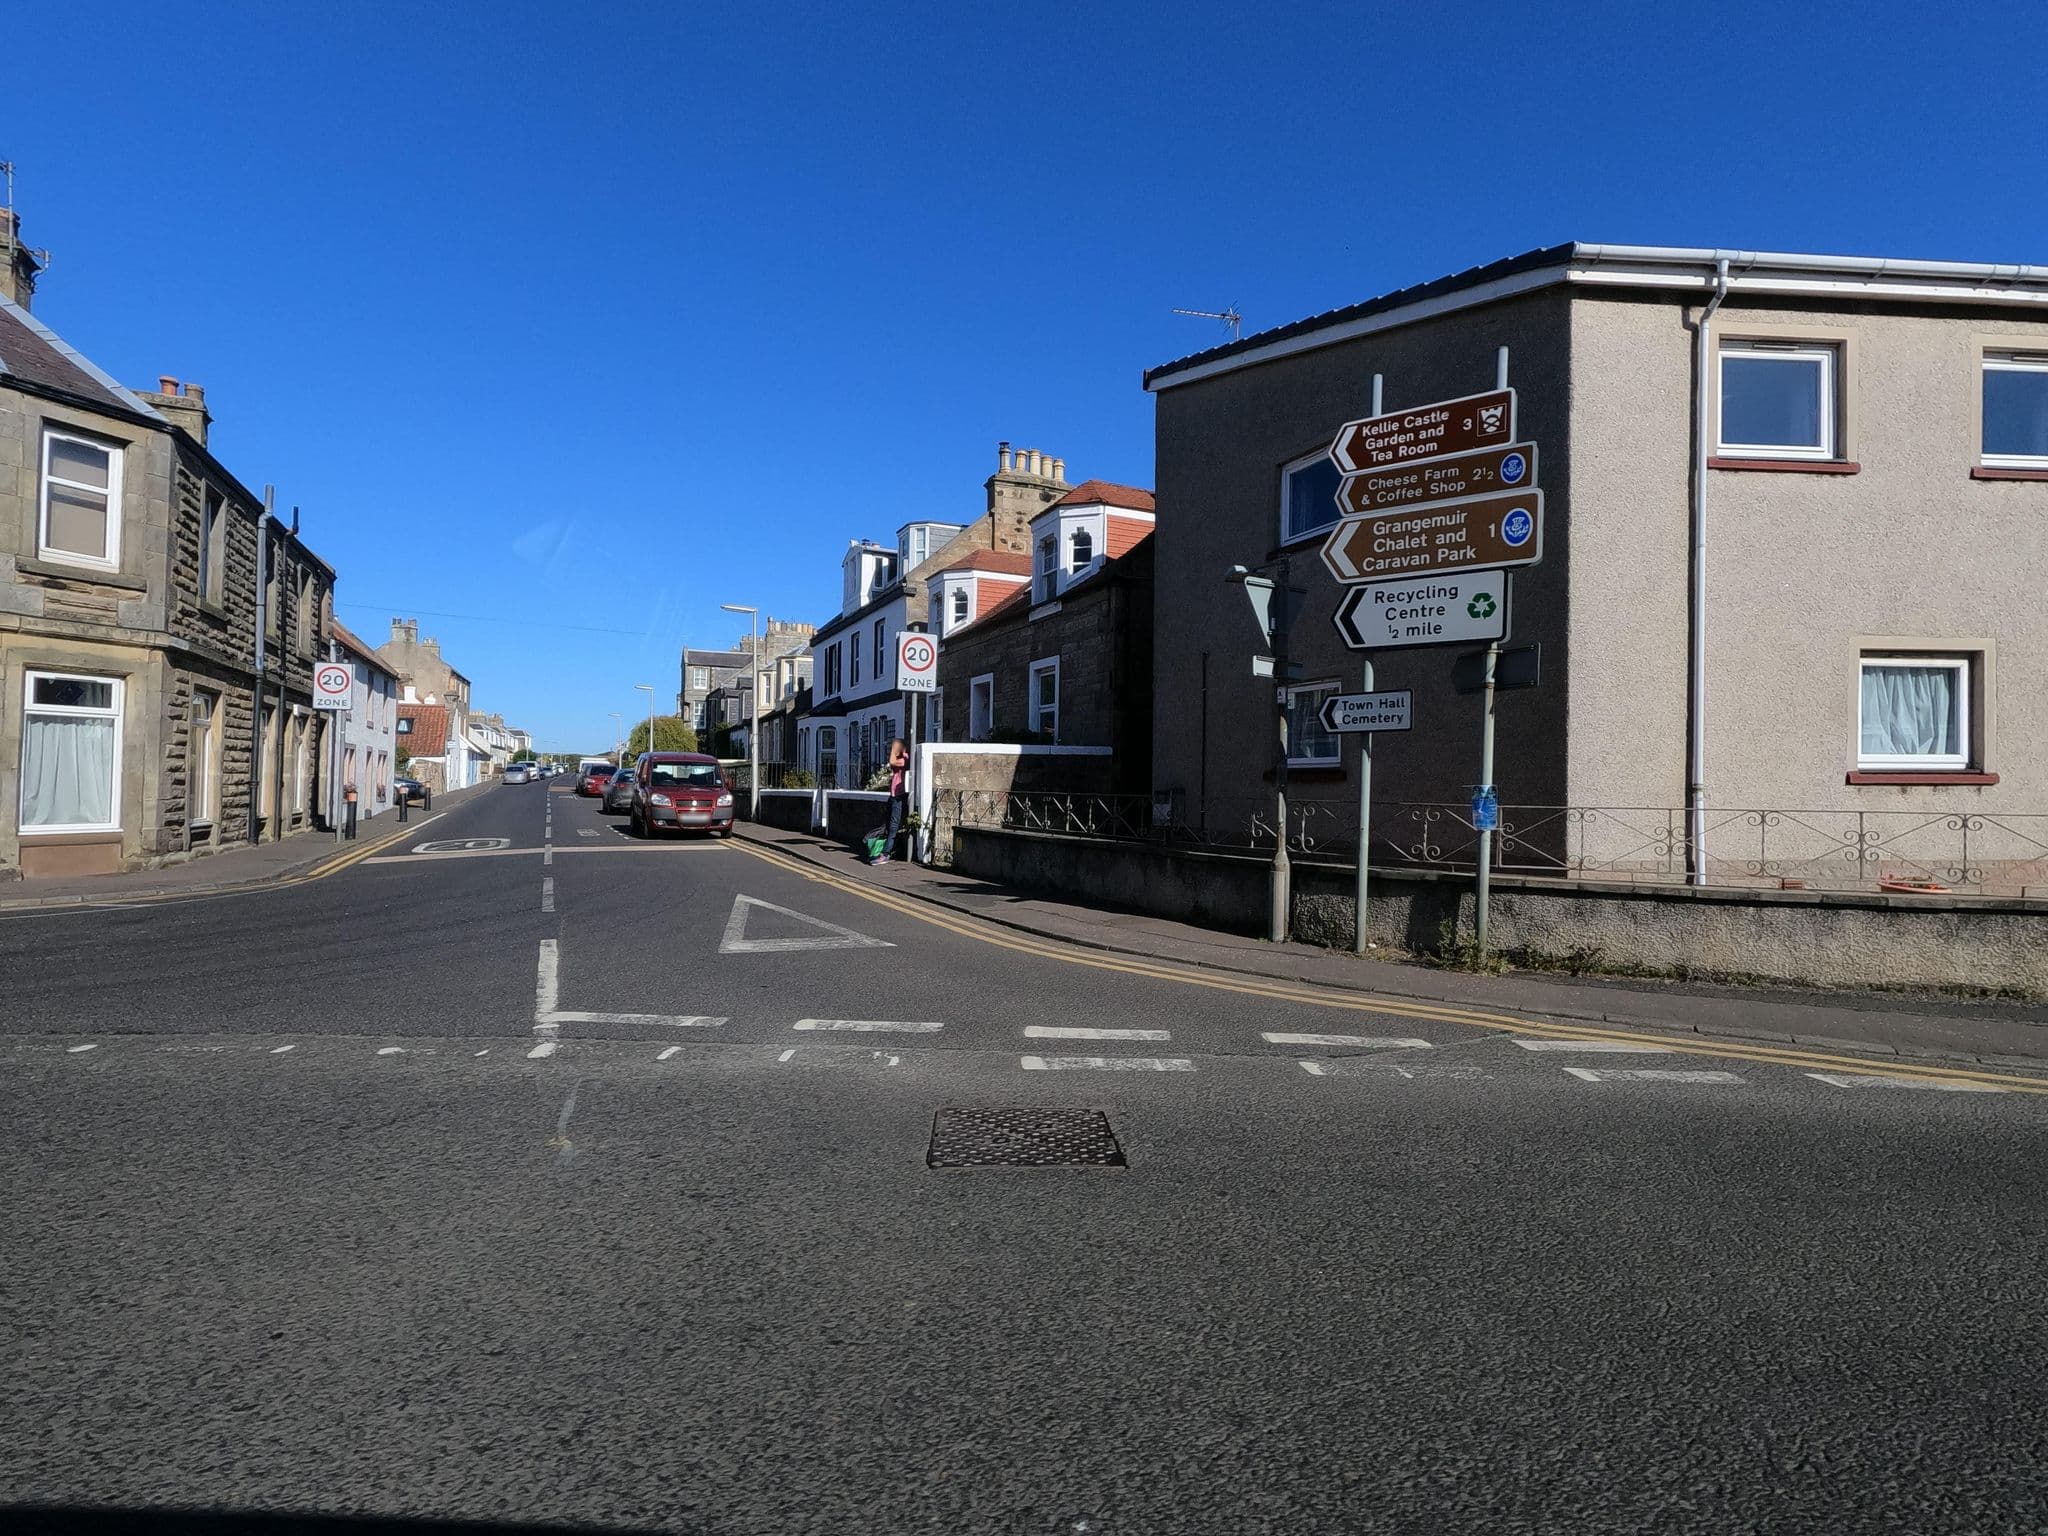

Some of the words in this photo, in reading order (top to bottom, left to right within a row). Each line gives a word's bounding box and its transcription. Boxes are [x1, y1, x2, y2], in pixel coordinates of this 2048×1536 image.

[1362, 421, 1400, 437] Kellie
[1404, 410, 1450, 428] Castle
[1462, 418, 1473, 431] 3
[1365, 432, 1415, 450] Garden
[1418, 424, 1445, 439] and
[1371, 450, 1393, 462] Tea
[1398, 442, 1438, 458] Room
[1368, 474, 1418, 490] Cheese
[1424, 467, 1460, 481] Farm
[1361, 494, 1371, 505] &
[1376, 487, 1423, 503] Coffee
[1430, 481, 1466, 495] Shop
[1373, 510, 1468, 535] Grangemuir
[1488, 523, 1496, 538] 1
[1373, 533, 1428, 553] Chalet
[1435, 528, 1467, 545] and
[1362, 553, 1430, 572] Caravan
[1437, 545, 1477, 563] Park
[1375, 585, 1459, 604] Recycling
[1385, 604, 1446, 621] Centre
[1406, 622, 1443, 637] mile
[907, 647, 930, 662] 20
[322, 674, 345, 686] 20
[902, 678, 933, 688] ZONE
[316, 698, 348, 707] ZONE
[1341, 701, 1373, 711] Town
[1379, 697, 1406, 709] Hall
[1342, 713, 1404, 725] Cemetery
